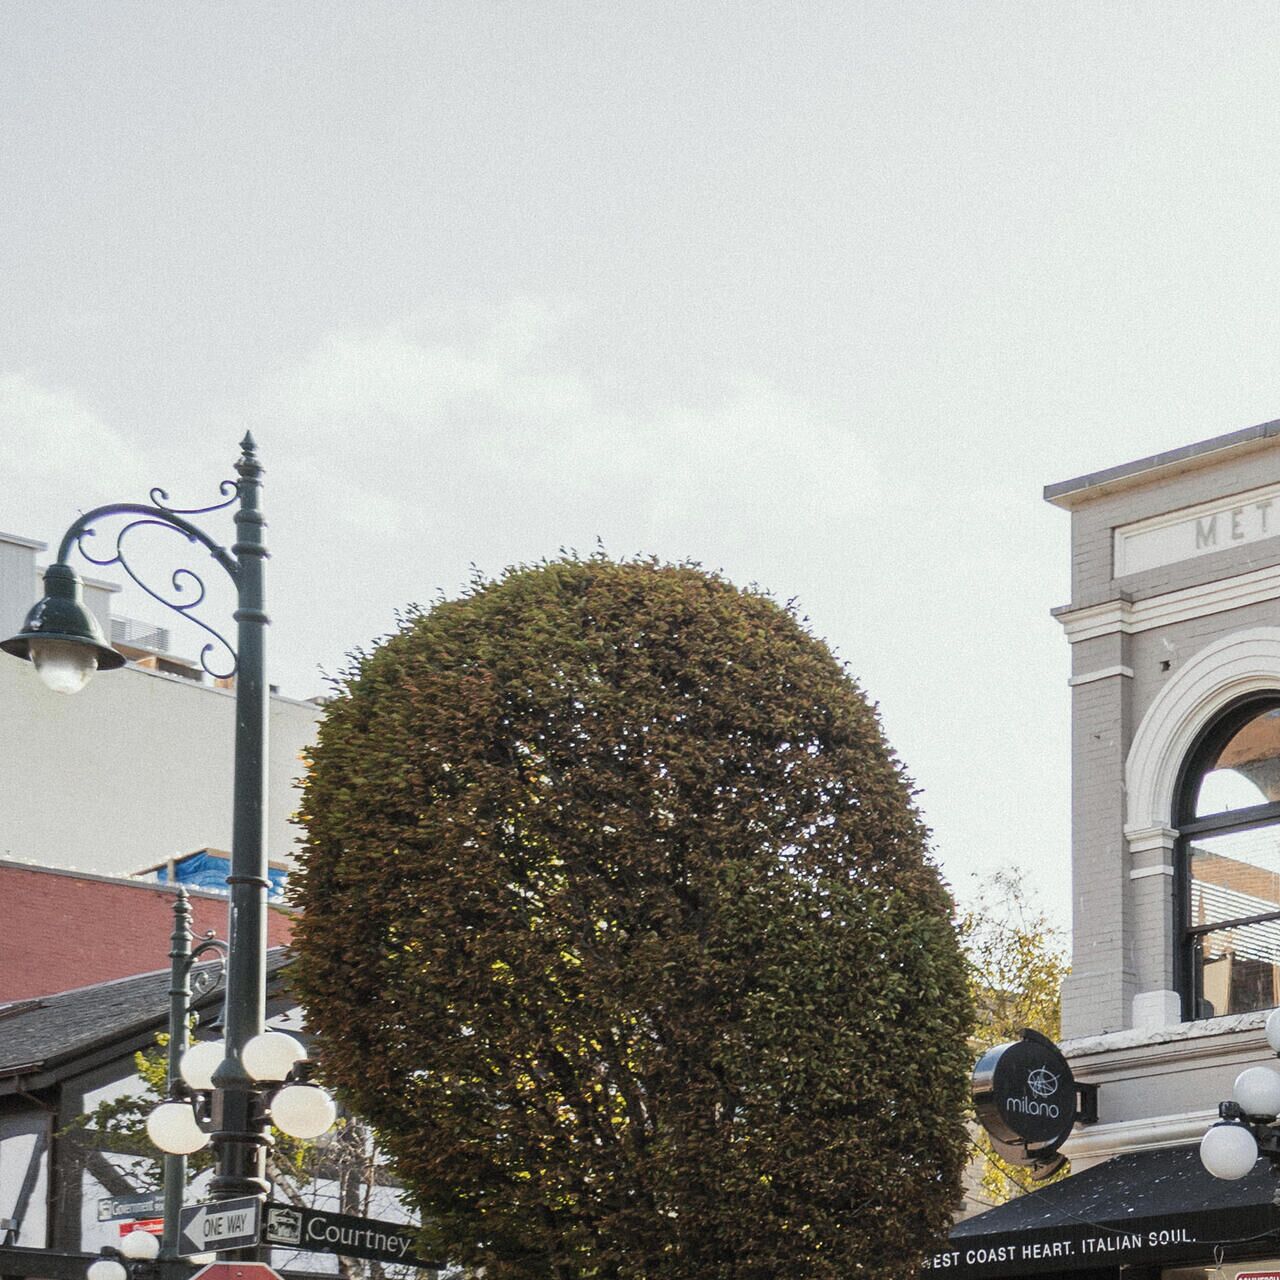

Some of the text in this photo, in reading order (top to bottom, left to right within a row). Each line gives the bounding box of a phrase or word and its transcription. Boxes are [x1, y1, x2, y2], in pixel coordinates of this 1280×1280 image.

[1006, 1096, 1059, 1118] milano
[203, 1214, 248, 1237] ONE WAY
[308, 1217, 412, 1257] Courtney
[966, 1246, 1016, 1265] COAST
[1022, 1241, 1076, 1259] HEART.
[1082, 1234, 1142, 1253] ITALIAN
[1148, 1228, 1196, 1247] SOUL.
